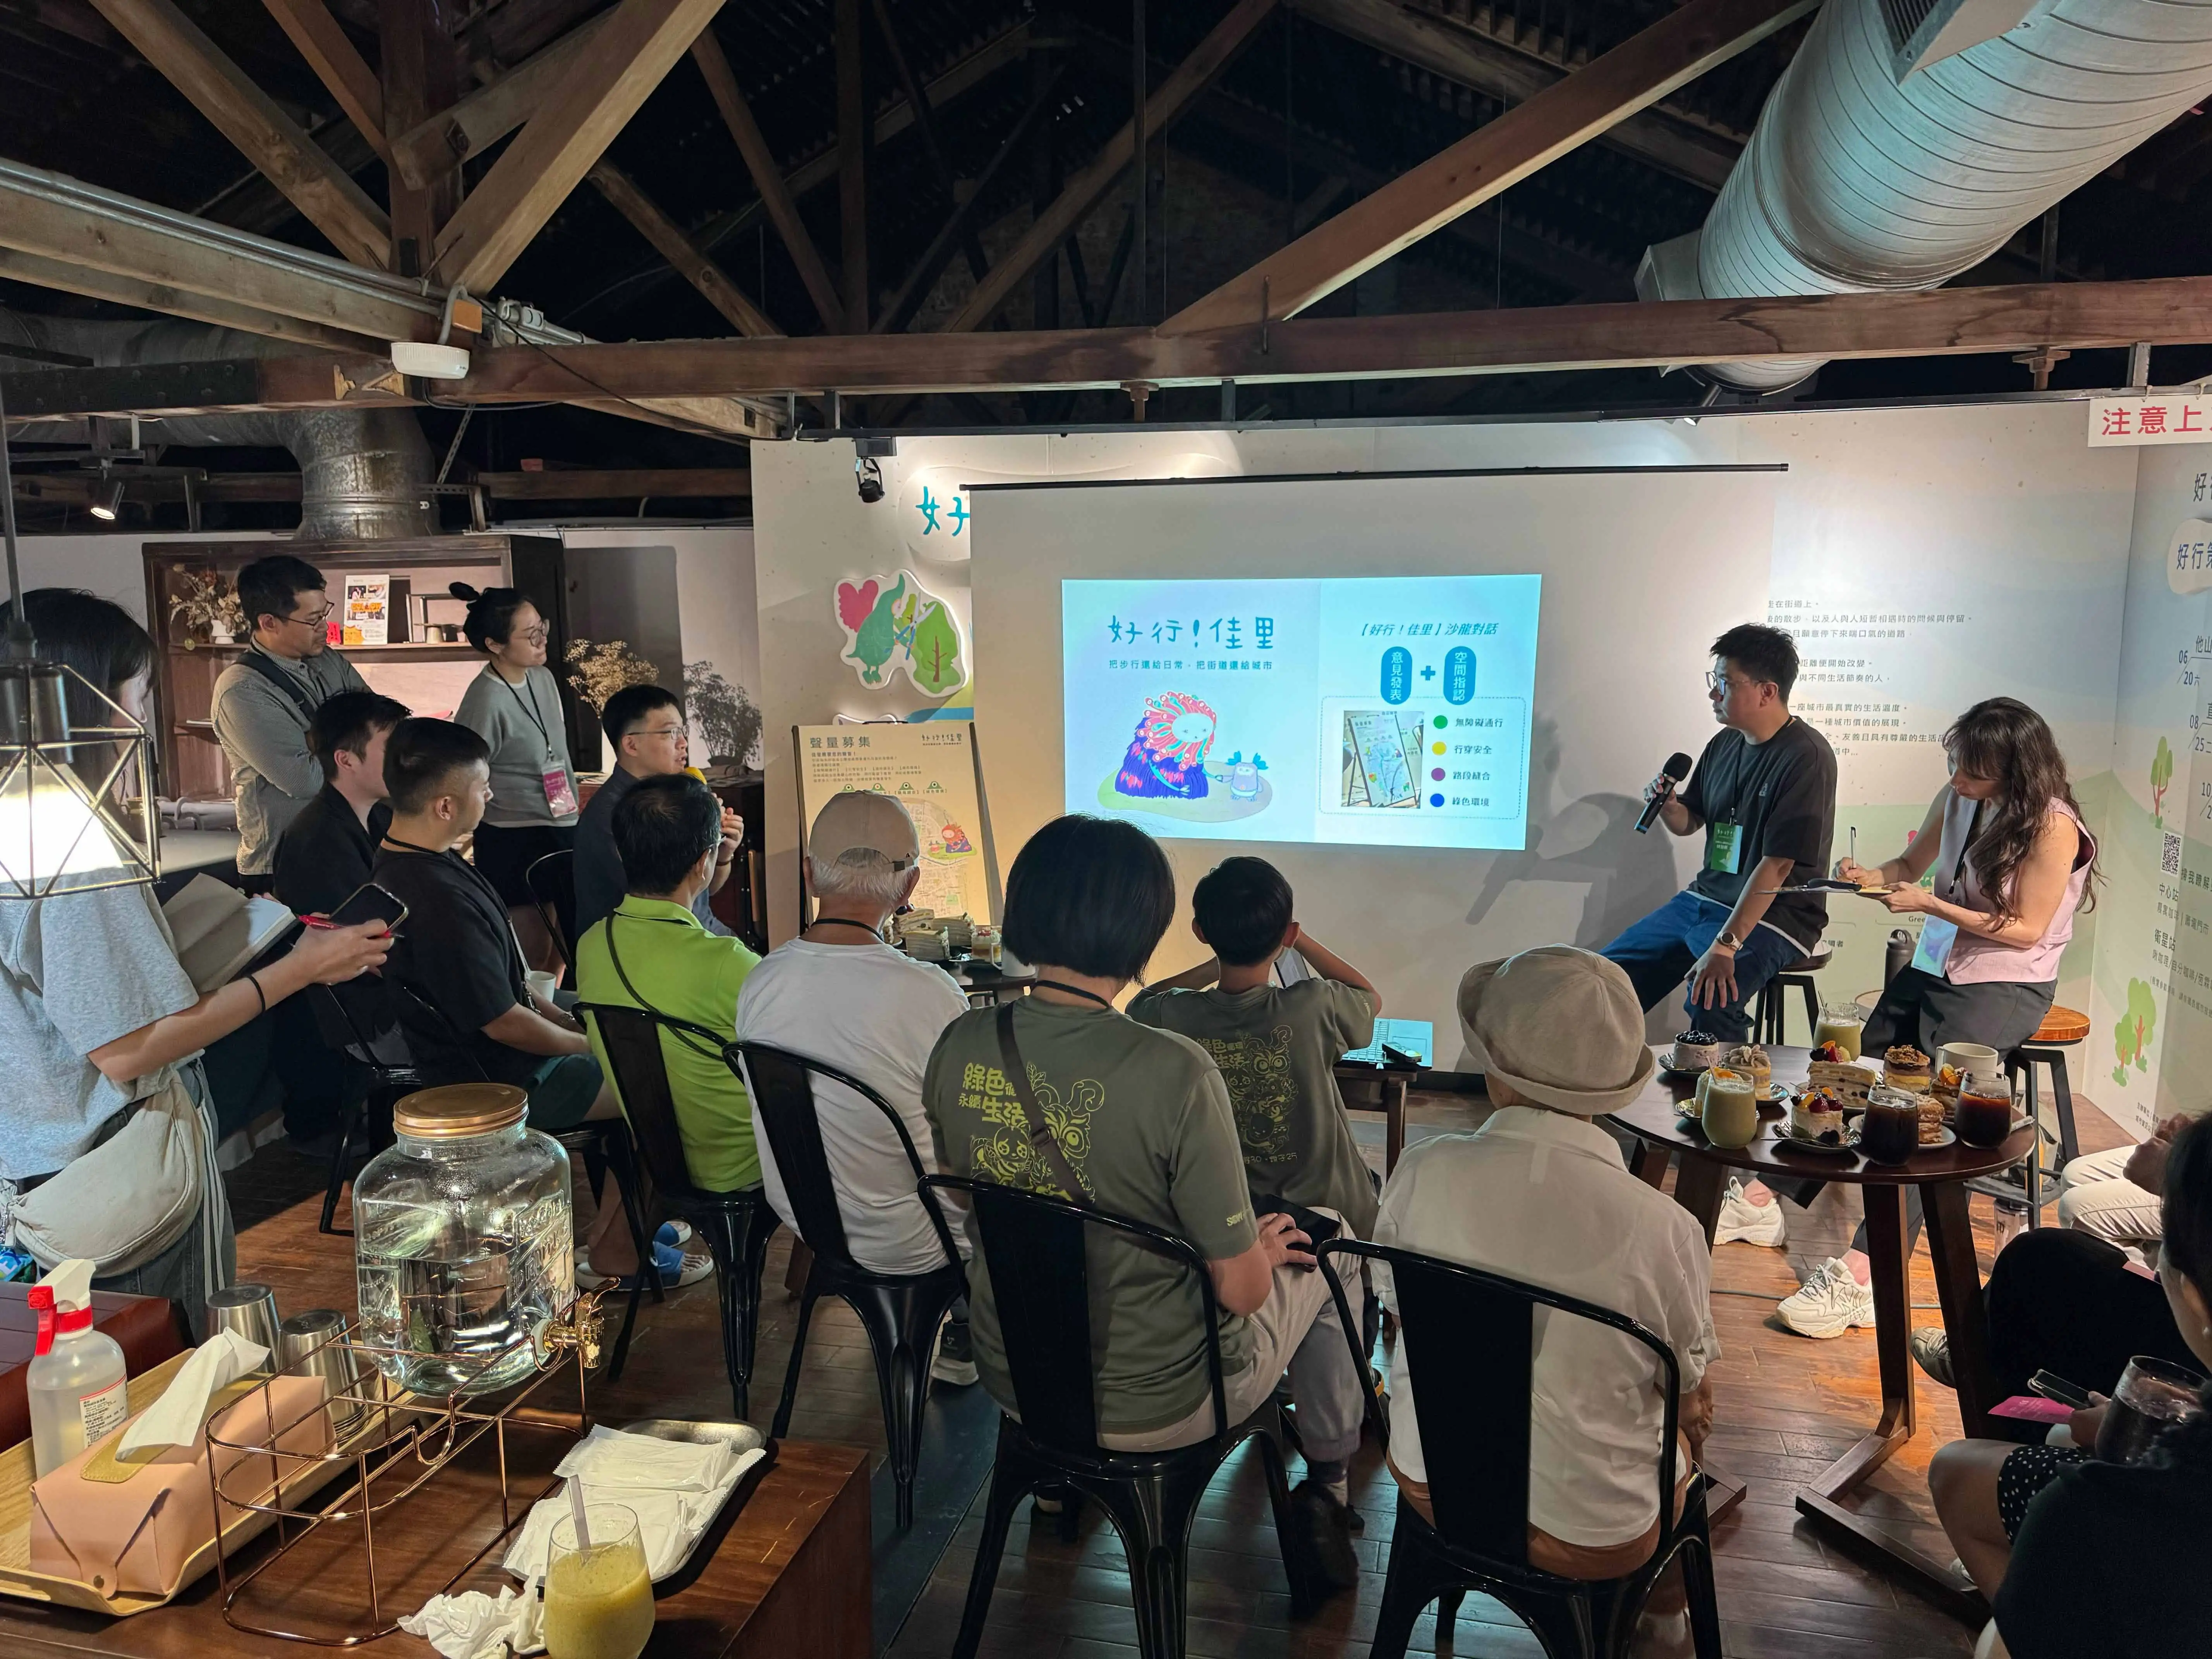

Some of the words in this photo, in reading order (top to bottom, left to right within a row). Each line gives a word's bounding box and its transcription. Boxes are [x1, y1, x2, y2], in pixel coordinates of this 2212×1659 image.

[2102, 405, 2212, 435] 注意上
[2193, 473, 2212, 502] 好
[2179, 650, 2188, 664] 06
[1390, 652, 1403, 701] 意見發表
[1453, 652, 1467, 701] 空間指認
[1455, 718, 1503, 728] 無障礙通行
[2190, 714, 2199, 729] 08
[1454, 745, 1492, 754] 行穿安全
[1453, 771, 1490, 781] 路段縫合
[1452, 797, 1489, 807] 綠色環境
[2181, 867, 2212, 892] 掃我瞭解
[2159, 883, 2179, 902] 中心站
[2154, 929, 2176, 952] 衛星站
